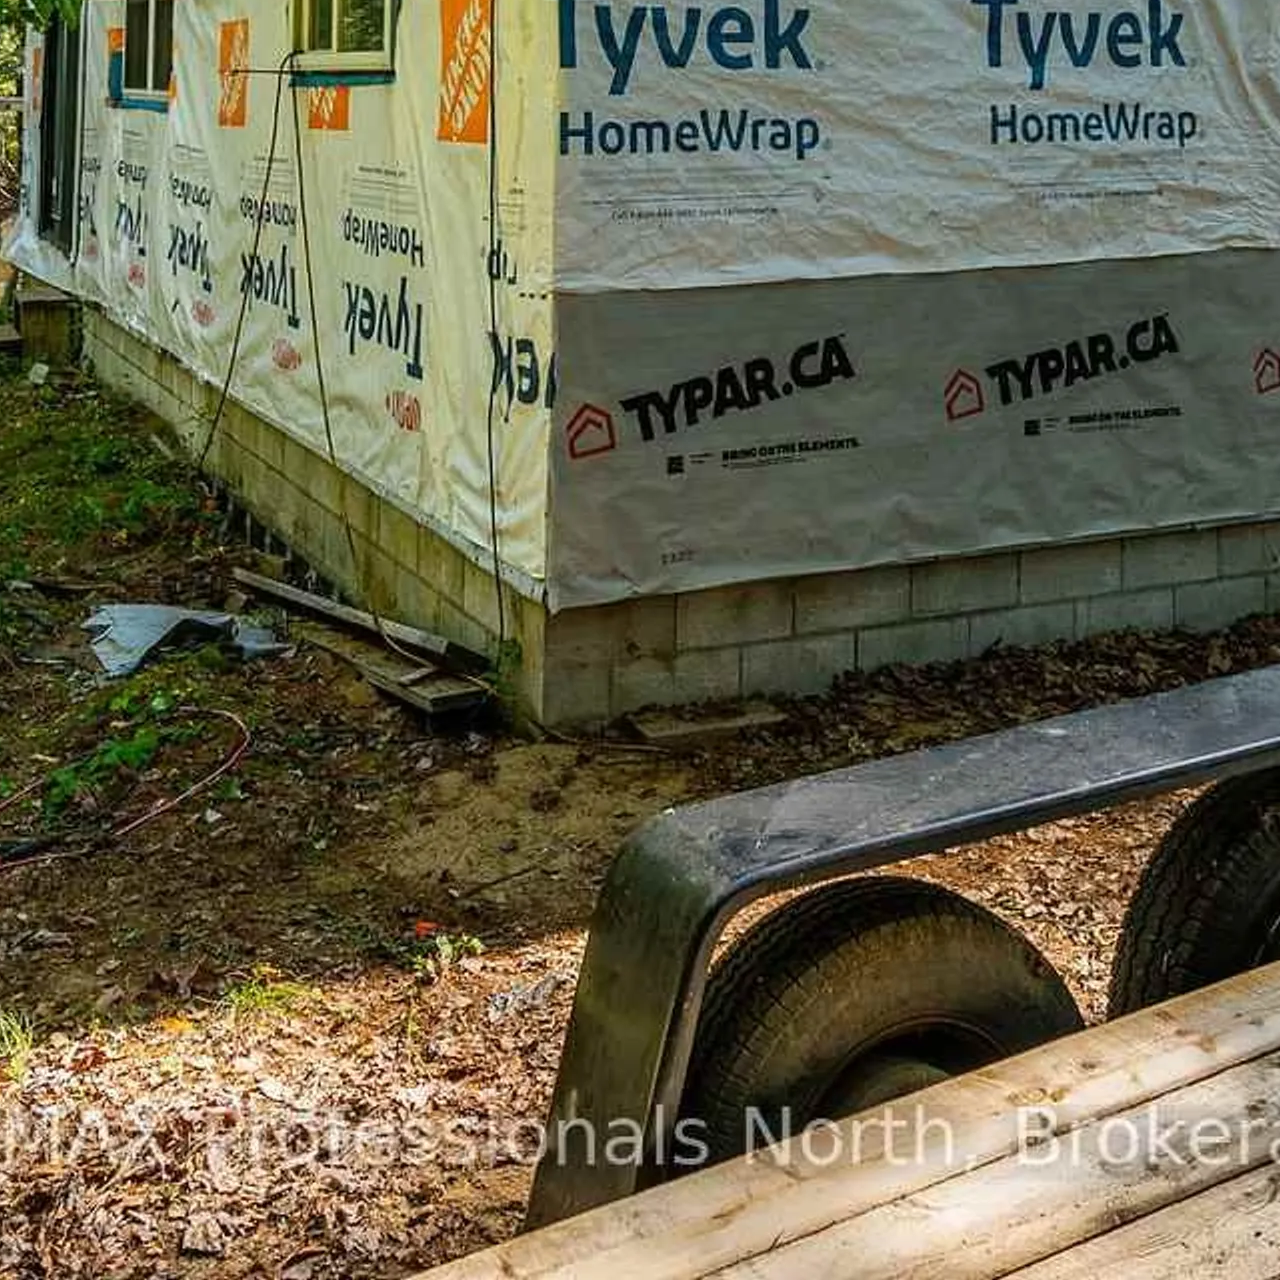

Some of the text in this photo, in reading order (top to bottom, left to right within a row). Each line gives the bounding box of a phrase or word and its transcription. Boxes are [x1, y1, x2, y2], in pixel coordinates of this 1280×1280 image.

[559, 108, 819, 160] HomeWrap
[990, 103, 1198, 147] HomeWrap
[344, 276, 424, 380] Tyvek
[985, 314, 1180, 407] TYPAR.CA
[620, 335, 857, 441] TYPAR.CA
